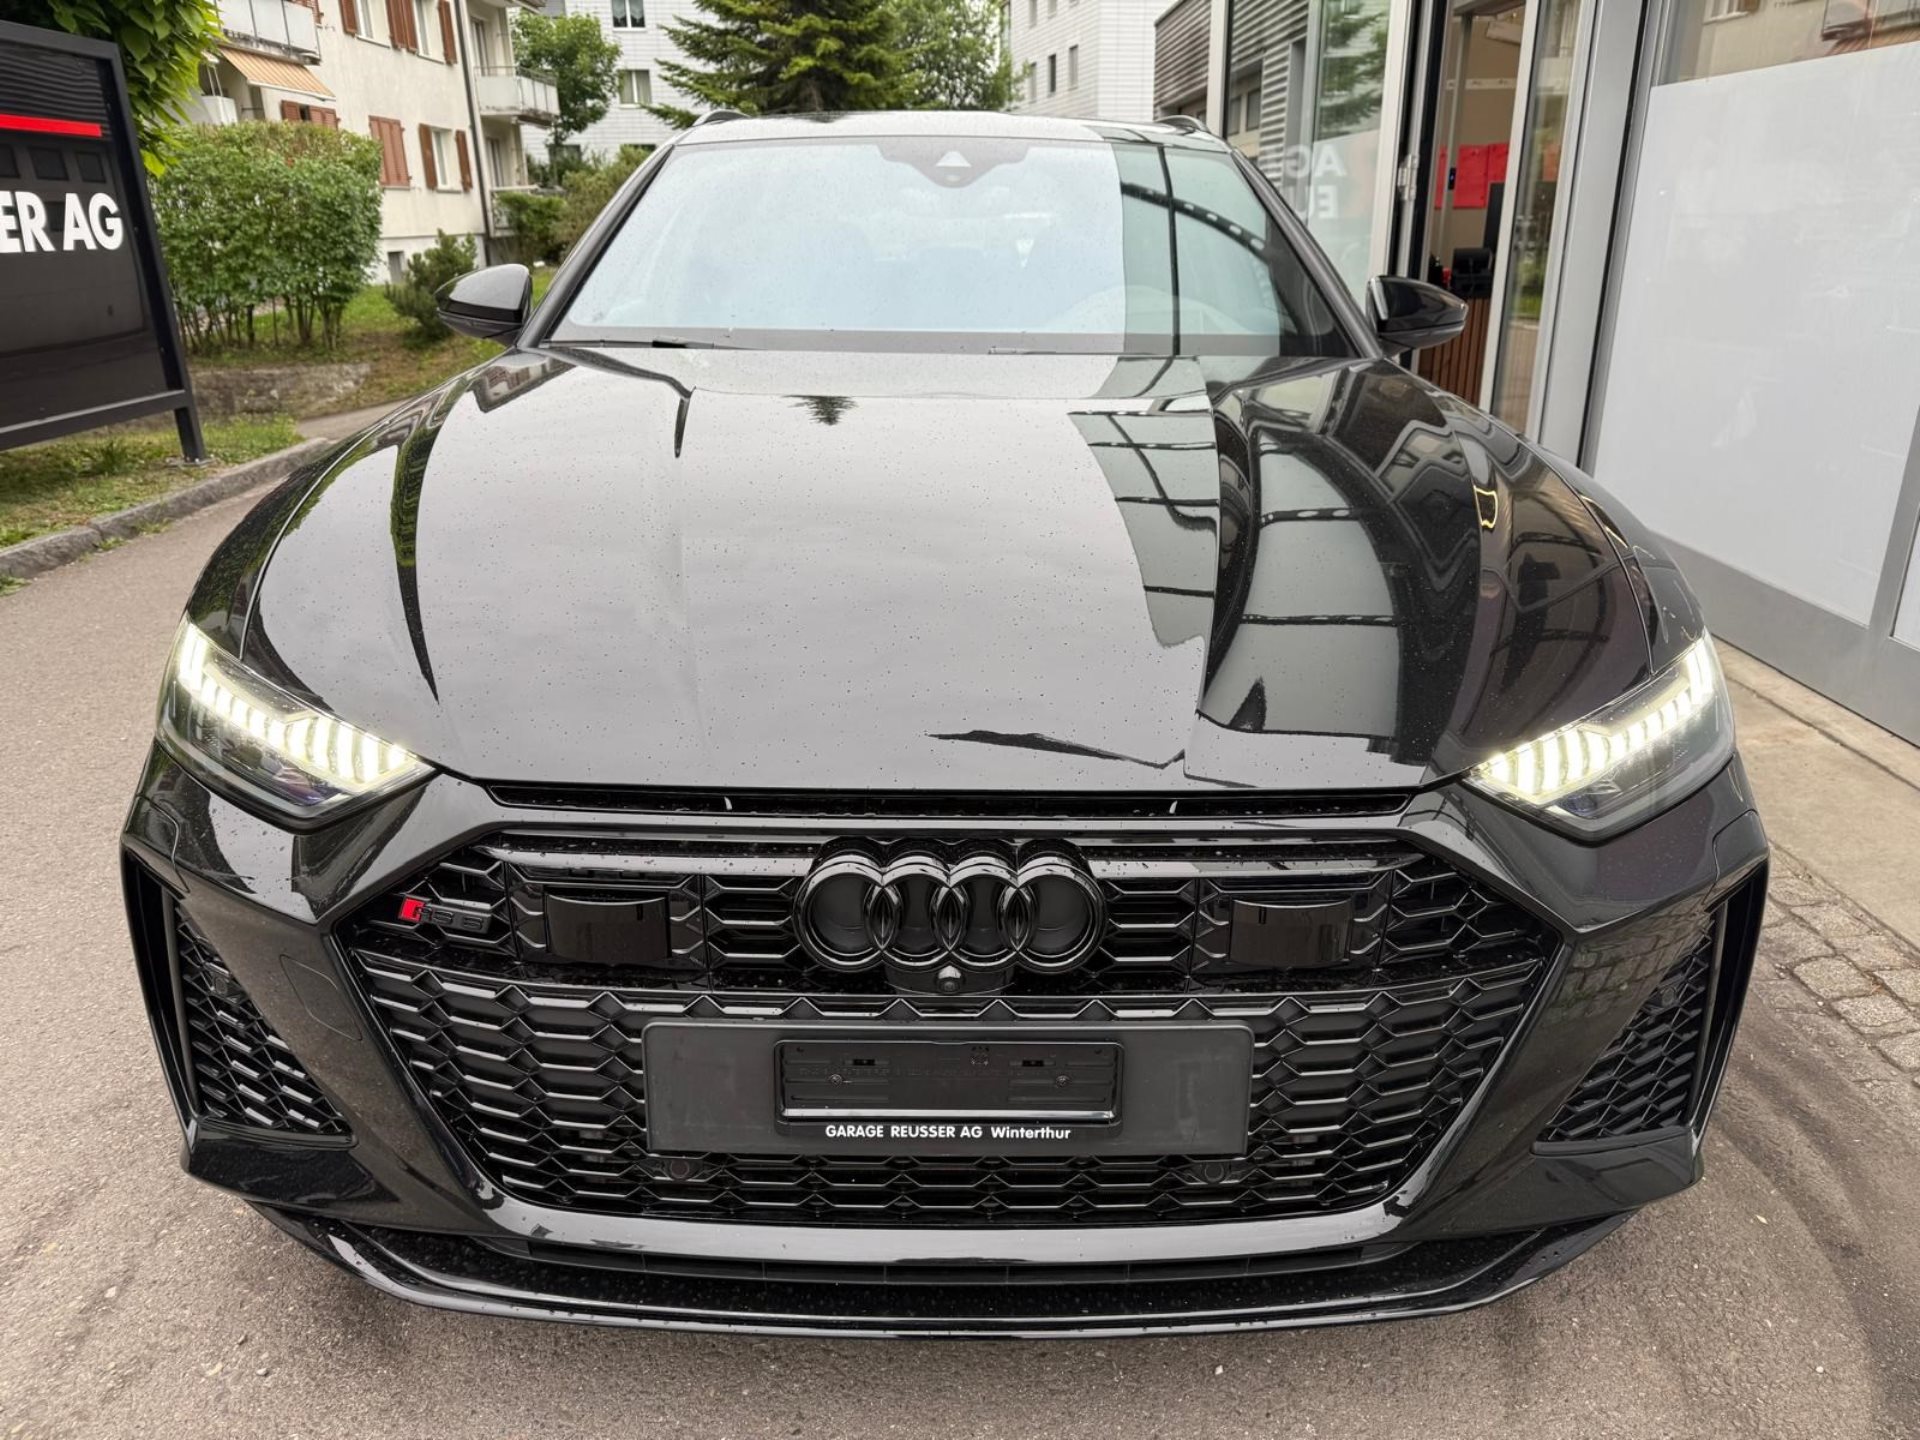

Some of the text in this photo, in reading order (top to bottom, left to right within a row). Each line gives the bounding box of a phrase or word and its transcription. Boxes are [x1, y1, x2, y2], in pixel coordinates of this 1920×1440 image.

[63, 192, 124, 251] AG
[825, 1124, 1071, 1139] GARAGE REUSSER AG Winterthur
